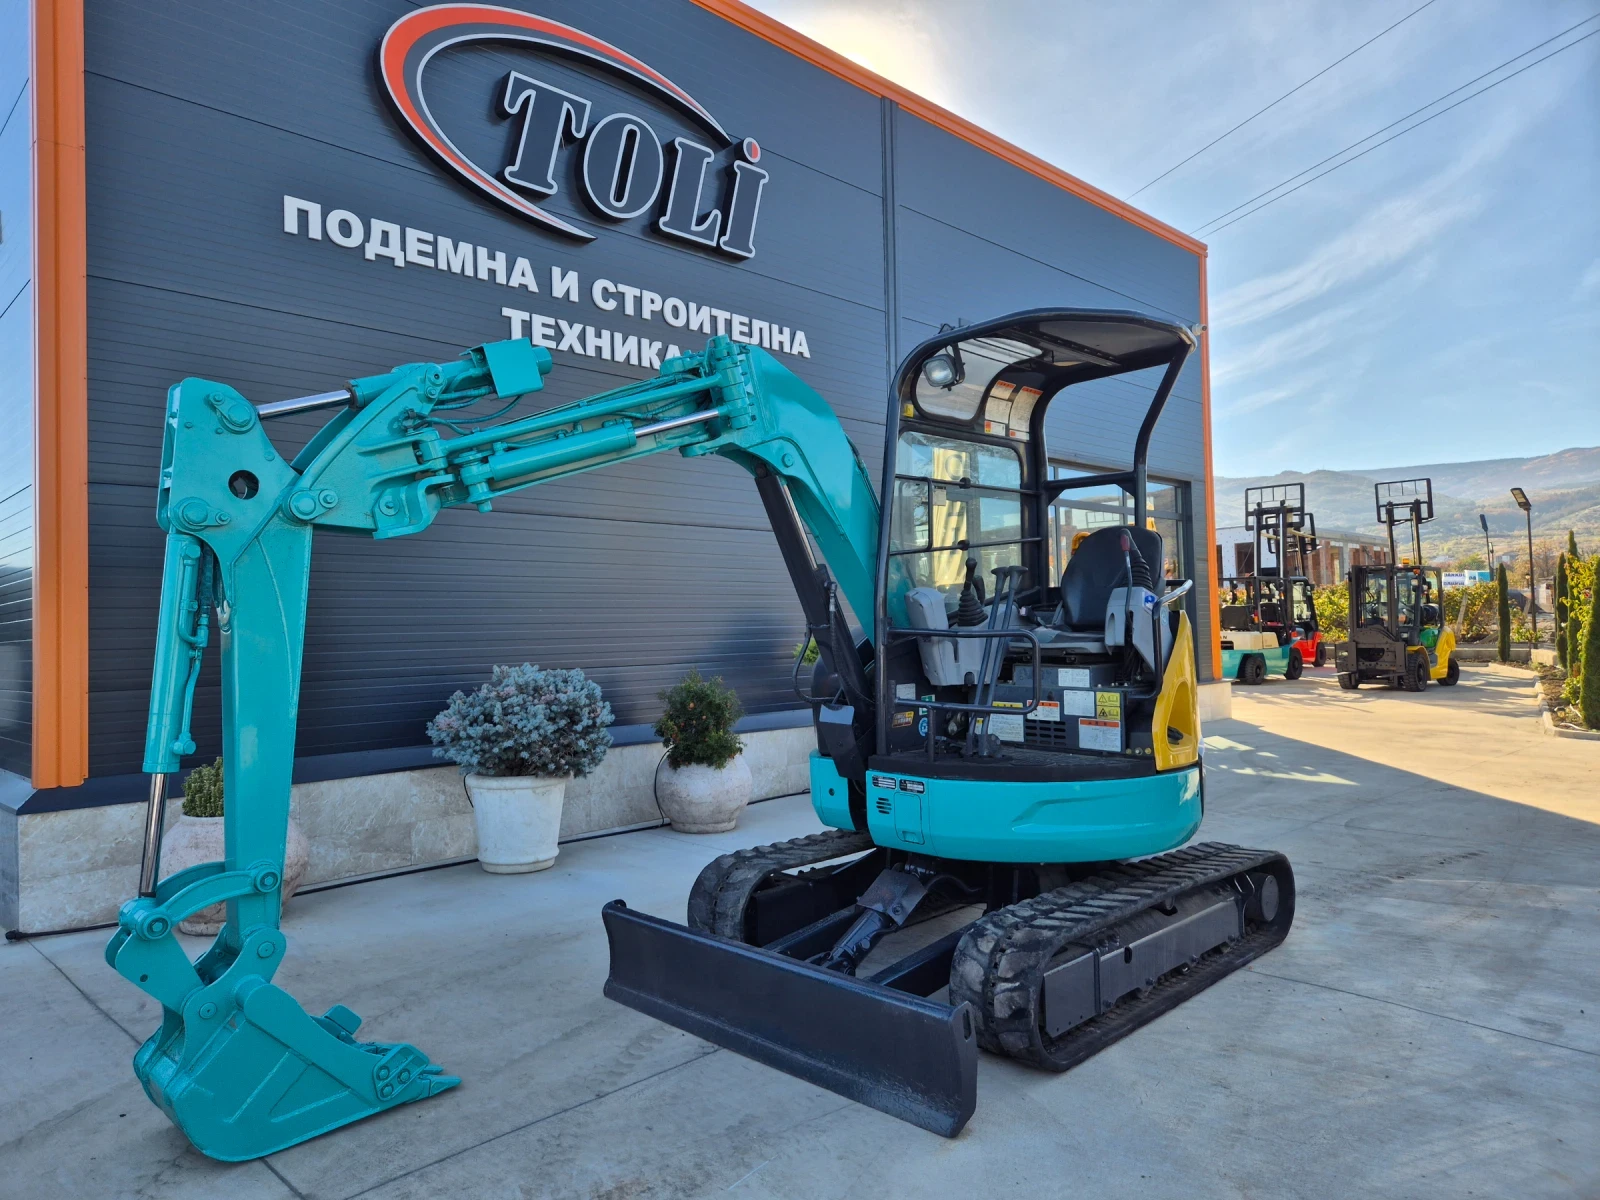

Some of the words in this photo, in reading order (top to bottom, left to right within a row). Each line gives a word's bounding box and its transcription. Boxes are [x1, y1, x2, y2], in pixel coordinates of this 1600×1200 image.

[283, 194, 539, 293] ПОДЕМНА
[551, 265, 579, 302] И
[592, 278, 811, 358] СТРОИТЕЛНА
